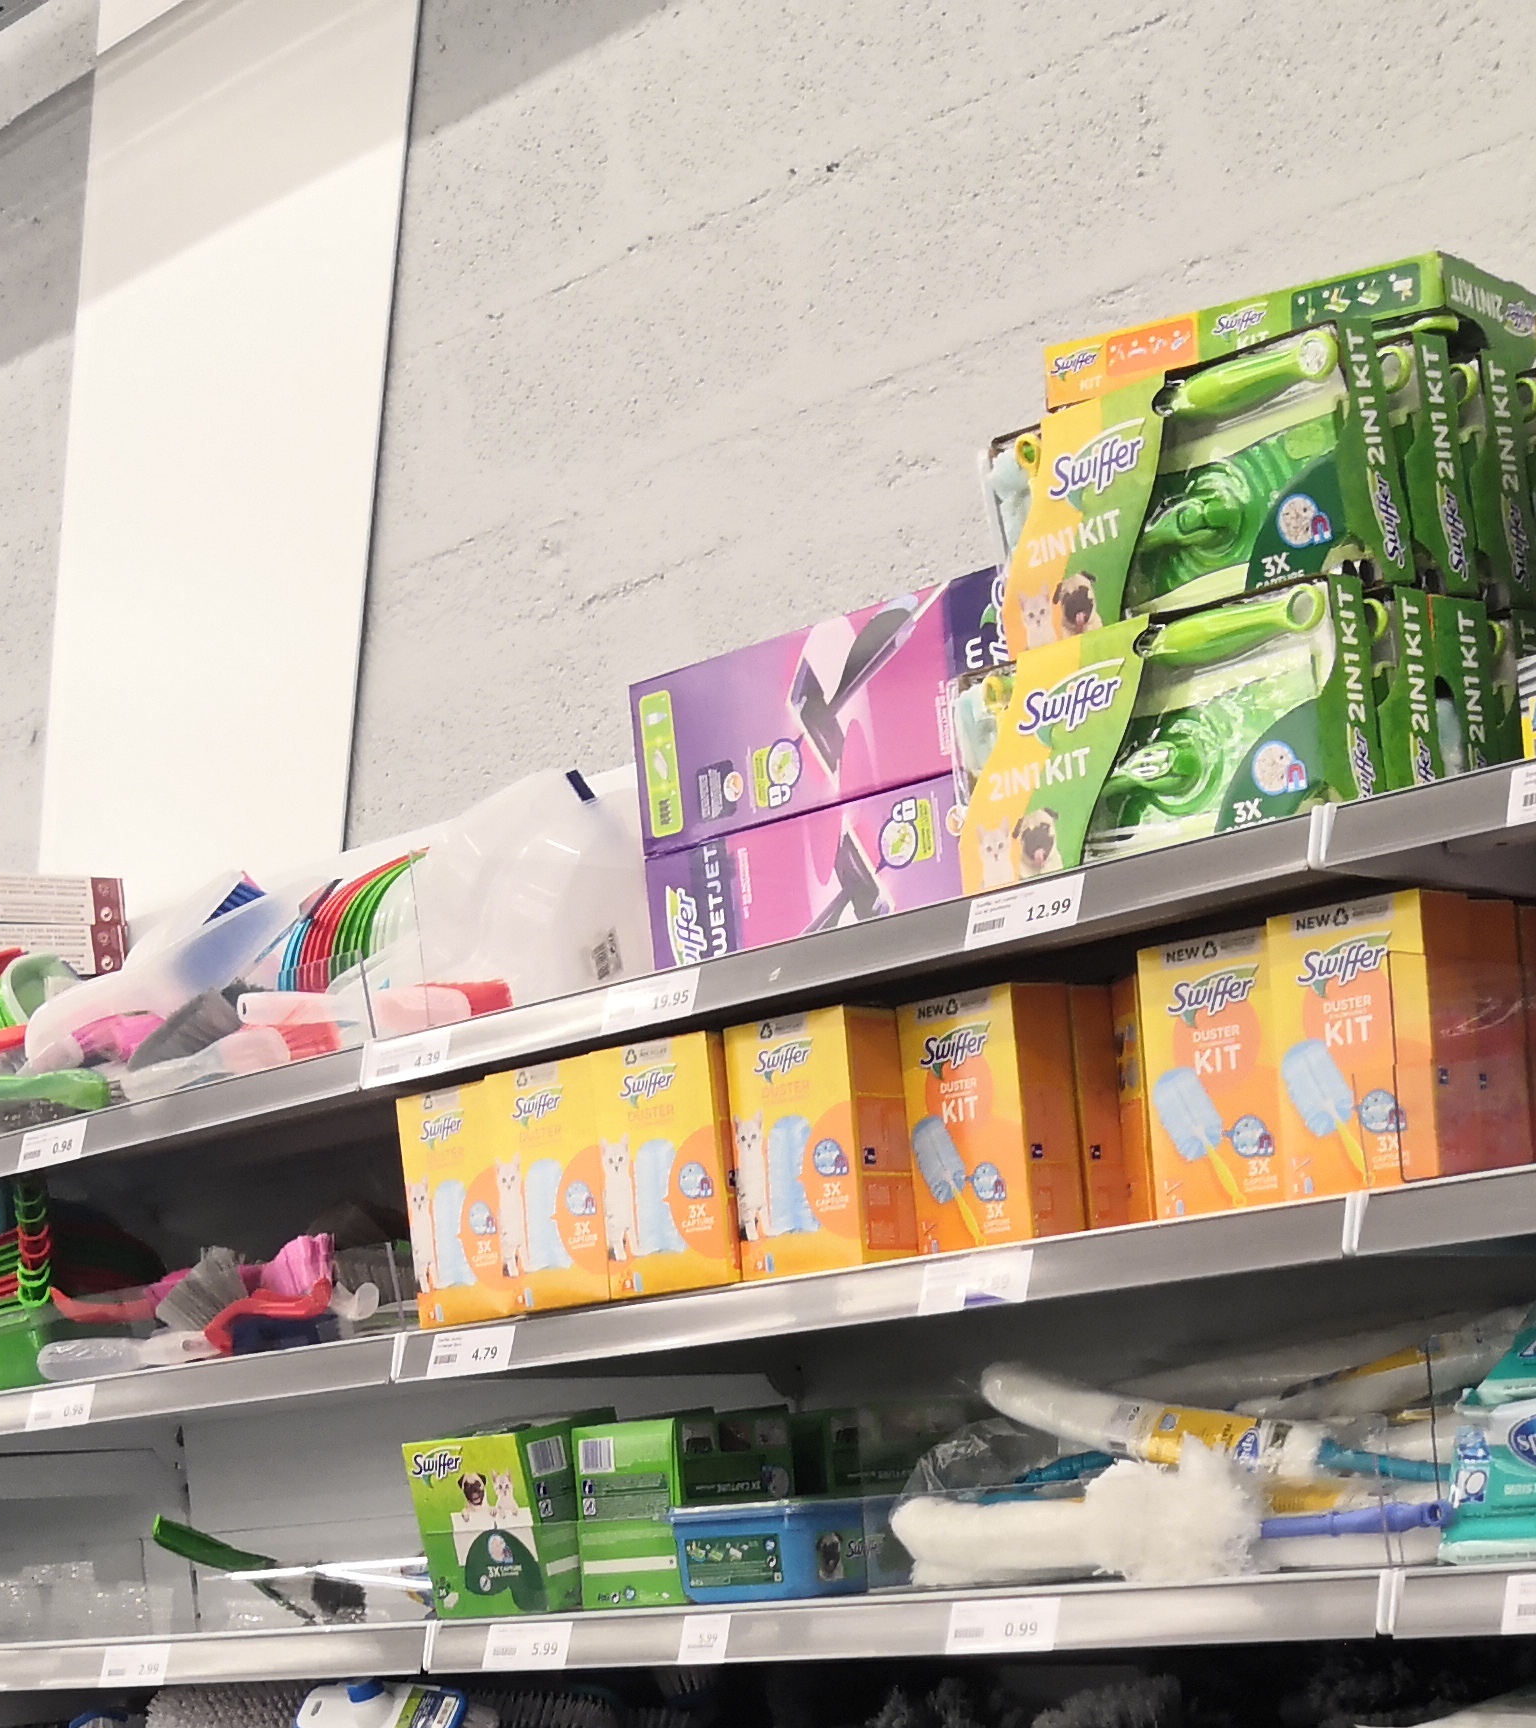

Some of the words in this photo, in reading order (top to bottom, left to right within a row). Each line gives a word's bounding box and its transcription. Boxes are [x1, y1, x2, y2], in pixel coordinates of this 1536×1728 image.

[1213, 306, 1266, 335] Swiffer
[1050, 350, 1099, 378] Swiffer
[1344, 327, 1370, 399] KIT
[1420, 345, 1446, 413] KIT
[1489, 361, 1513, 427] KIT
[1365, 401, 1387, 468] 2IN1
[1435, 418, 1457, 481] 2IN1
[1049, 432, 1145, 500] Swiffer
[1027, 529, 1075, 569] 2IN1
[1077, 509, 1120, 545] KIT
[1260, 553, 1290, 575] 3X
[1341, 585, 1360, 655] KIT
[1401, 597, 1428, 666] KIT
[1018, 674, 1122, 736] Swiffer
[1348, 658, 1367, 726] 2IN1
[1410, 667, 1432, 739] 2IN1
[988, 764, 1042, 800] 2IN1
[1043, 747, 1092, 785] KIT
[1233, 799, 1262, 822] 3X
[704, 848, 728, 956] WETJET
[1025, 897, 1072, 922] 12.99
[1296, 914, 1330, 932] NEW
[1165, 947, 1199, 964] NEW
[1297, 941, 1388, 985] Swiffer
[652, 990, 690, 1010] 19.95
[1167, 972, 1254, 1016] Swiffer
[1322, 994, 1373, 1015] DUSTER
[918, 1003, 945, 1020] NEW
[919, 1024, 990, 1069] Swiffer
[1192, 1024, 1240, 1043] DUSTER
[1324, 1016, 1373, 1046] KIT
[414, 1049, 441, 1068] 4.39
[755, 1041, 812, 1076] Swiffer
[1193, 1044, 1241, 1075] KIT
[622, 1066, 676, 1105] Swiffer
[940, 1077, 978, 1095] DUSTER
[512, 1089, 563, 1127] Swiffer
[942, 1094, 980, 1125] KIT
[420, 1110, 464, 1142] Swiffer
[52, 1139, 74, 1157] 0.98
[471, 1345, 498, 1362] 4.79
[412, 1452, 463, 1479] Swiffer
[1004, 1620, 1039, 1637] 0.99
[531, 1641, 558, 1657] 5.99
